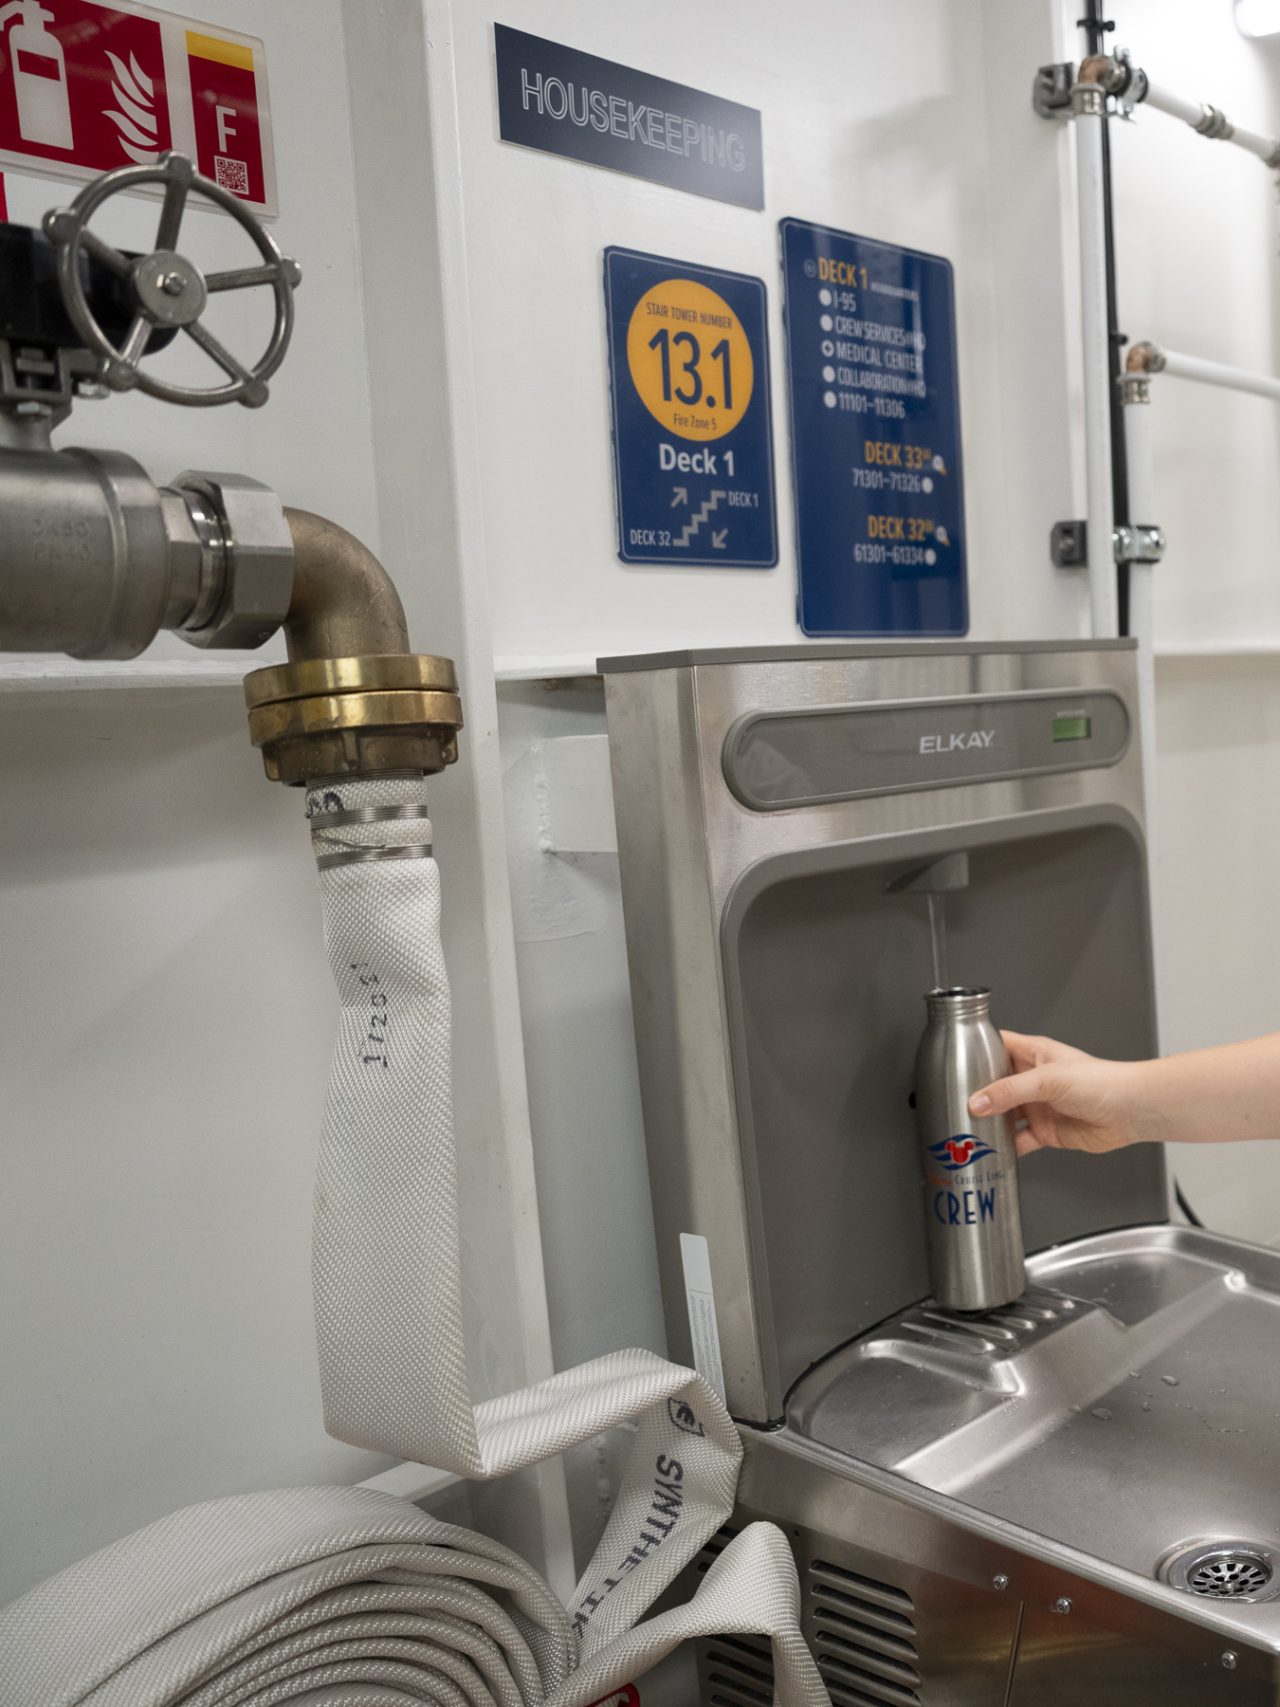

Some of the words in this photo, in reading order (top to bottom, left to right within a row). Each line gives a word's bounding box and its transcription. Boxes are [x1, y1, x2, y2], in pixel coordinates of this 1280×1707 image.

[216, 105, 237, 153] F
[521, 68, 746, 172] HOUSEKEEPING
[818, 256, 857, 288] DECK
[860, 267, 869, 289] 1
[647, 302, 669, 318] STAIR
[671, 307, 698, 323] TOWER
[700, 313, 733, 329] NUMBER
[835, 315, 862, 339] CREW
[648, 328, 733, 410] 13.1
[836, 341, 882, 366] MEDICAL
[884, 348, 923, 374] CENTER
[673, 413, 688, 427] Fire
[691, 415, 710, 429] Zone
[659, 443, 717, 475] Deck
[724, 451, 734, 476] 1
[864, 440, 902, 466] DECK
[728, 491, 753, 507] DECK
[754, 494, 759, 508] 1
[630, 529, 656, 546] DECK
[657, 531, 671, 547] 32
[868, 515, 904, 540] DECK
[920, 730, 995, 754] ELKAY
[935, 1187, 995, 1225] CREW
[572, 1454, 683, 1638] SYNTHETIK
